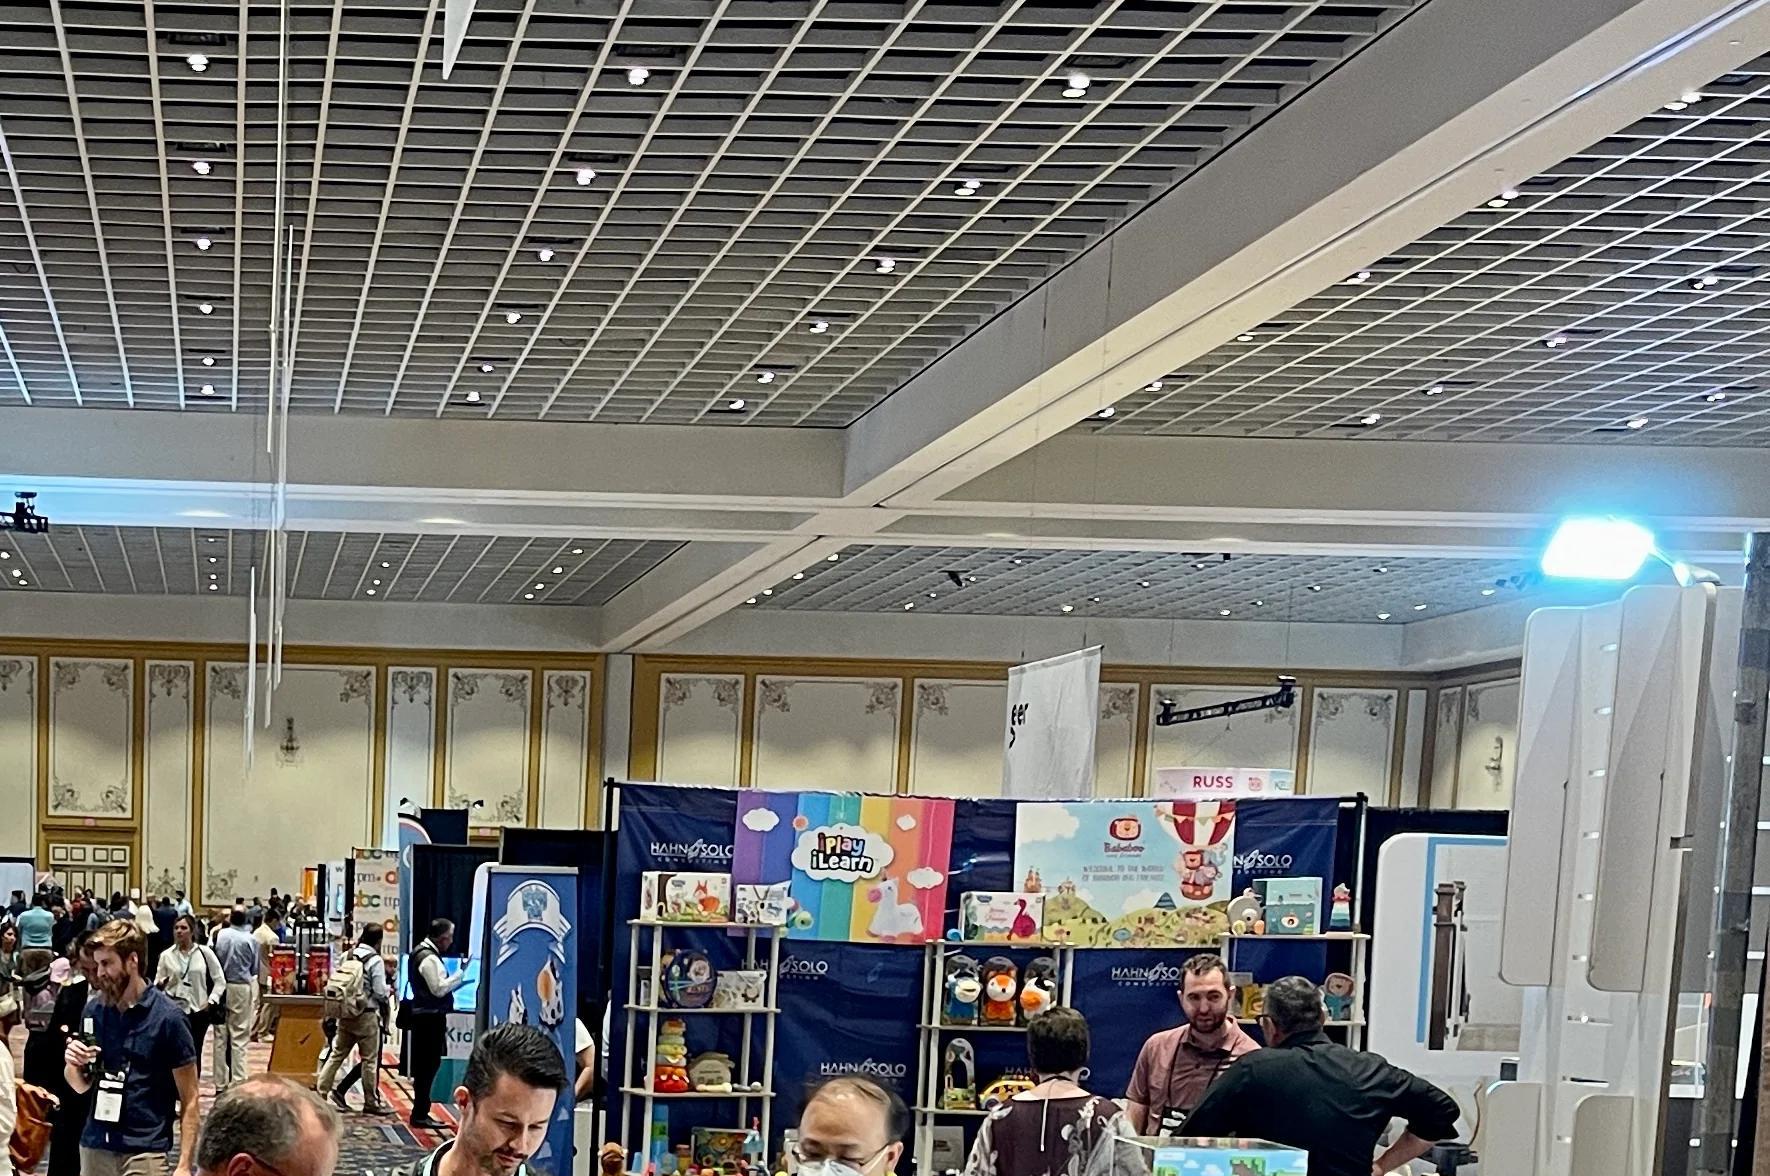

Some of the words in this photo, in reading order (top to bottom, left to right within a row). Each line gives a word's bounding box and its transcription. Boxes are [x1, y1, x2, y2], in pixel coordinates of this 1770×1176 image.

[1193, 775, 1233, 788] RUSS
[651, 842, 688, 855] HAHN
[810, 849, 874, 873] iLearn
[1257, 855, 1292, 867] SOLO
[792, 961, 828, 972] SOLO
[1112, 967, 1148, 978] HAHN
[821, 1063, 858, 1073] HAHN
[871, 1063, 906, 1076] SOLO
